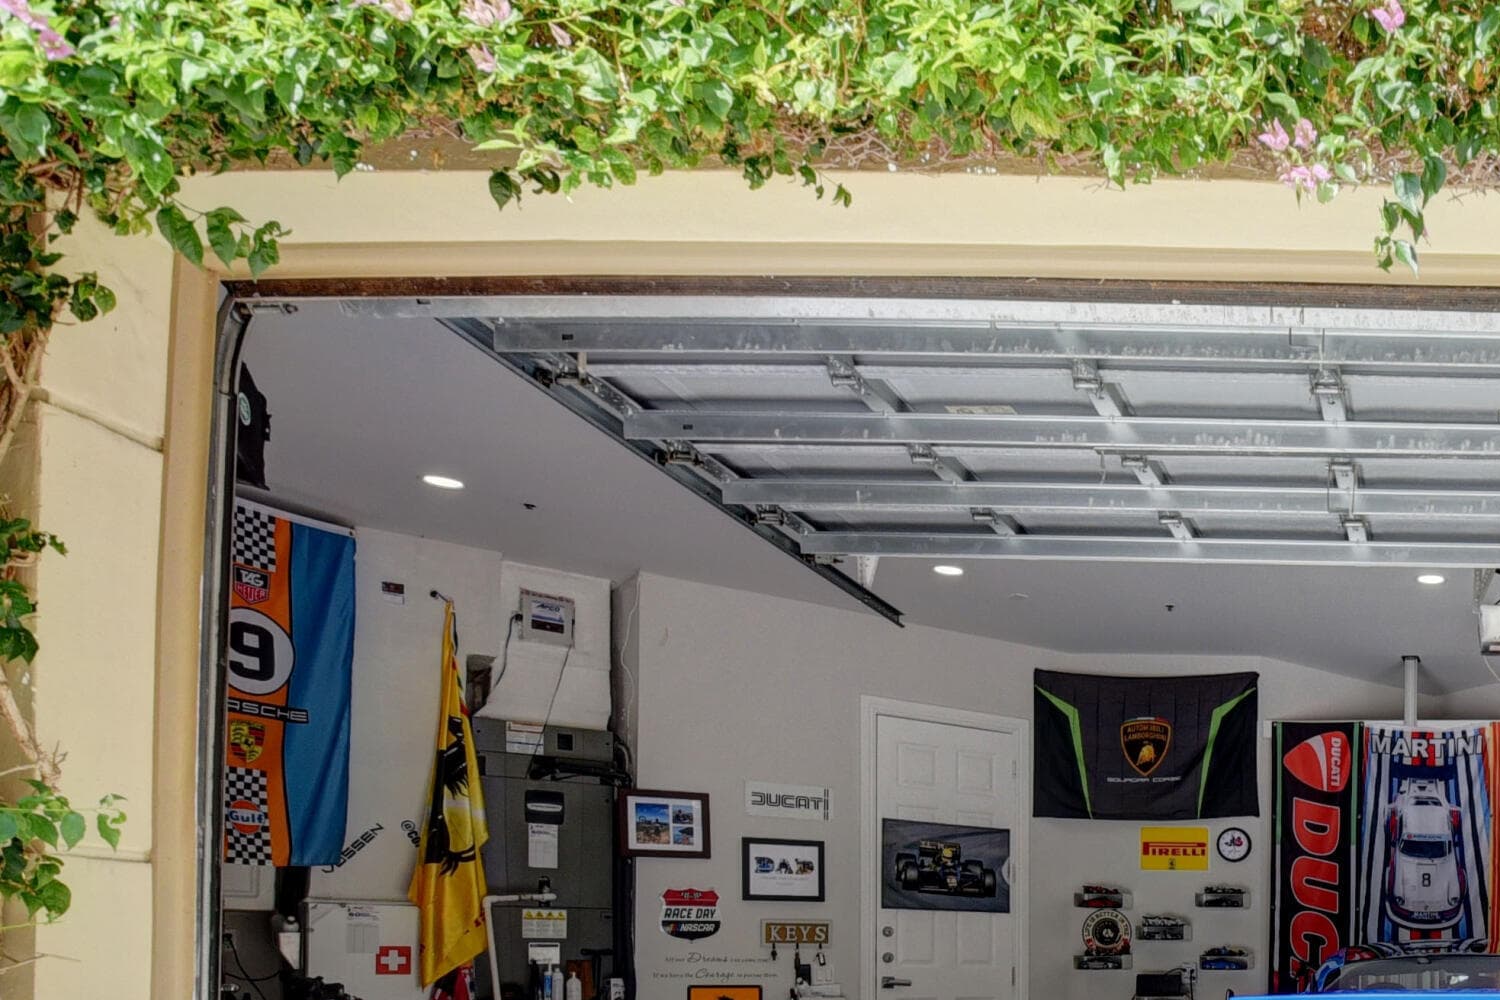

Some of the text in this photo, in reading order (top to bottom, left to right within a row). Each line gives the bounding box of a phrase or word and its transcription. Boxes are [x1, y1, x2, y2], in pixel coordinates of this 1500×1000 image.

[239, 569, 264, 586] TAG
[236, 584, 266, 600] HEUER
[229, 621, 275, 681] 9
[228, 699, 308, 722] RSCHE
[1371, 734, 1483, 758] MARTINI
[1330, 737, 1341, 787] DUCATI
[751, 788, 829, 821] DUCATI
[229, 808, 265, 824] Gulf
[1142, 842, 1207, 856] PIRELLI
[754, 856, 814, 875] DAD
[1290, 797, 1341, 980] DUC
[1422, 873, 1431, 887] 8
[664, 907, 716, 919] RACE DAY
[680, 923, 716, 932] NASCAR
[769, 924, 827, 941] KEYS
